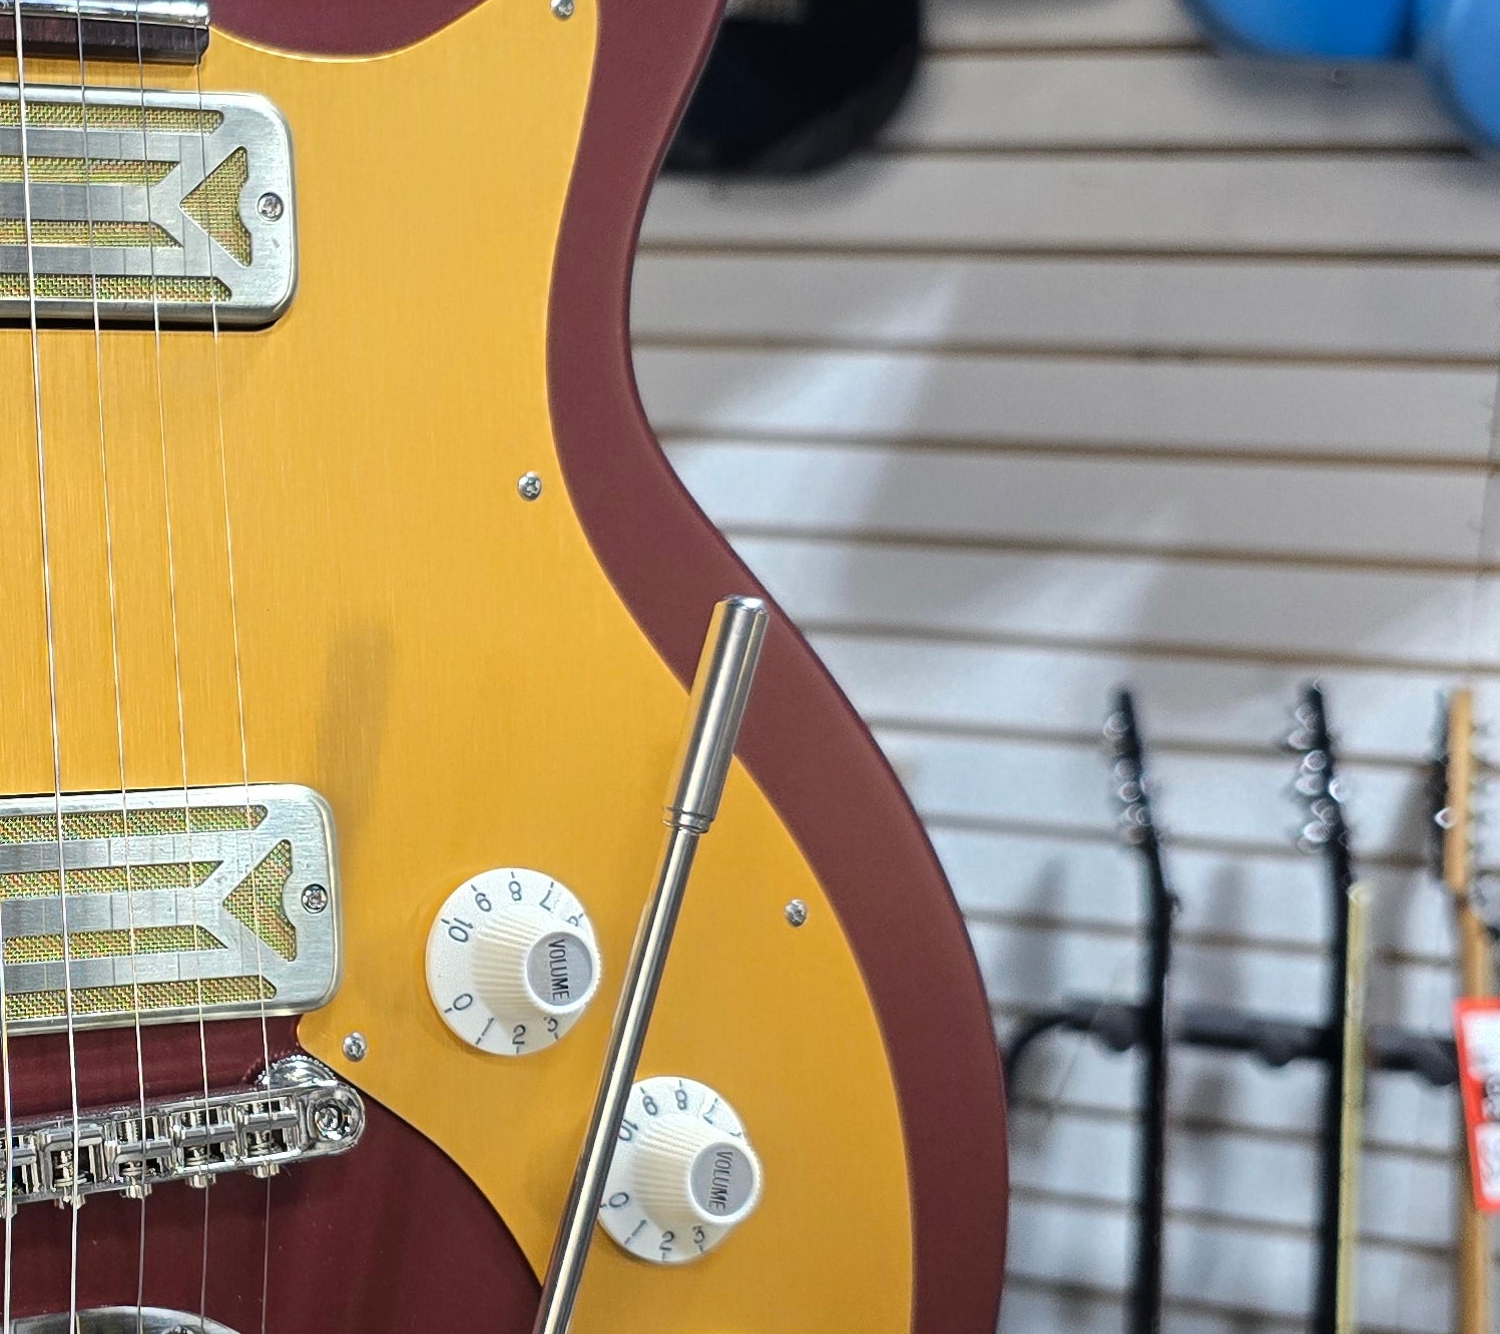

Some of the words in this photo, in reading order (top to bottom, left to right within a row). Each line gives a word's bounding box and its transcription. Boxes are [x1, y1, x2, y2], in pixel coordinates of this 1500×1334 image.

[508, 880, 523, 902] 8
[447, 917, 474, 943] 10
[548, 939, 570, 1001] VOLUME
[452, 993, 473, 1011] 0
[512, 1024, 526, 1045] 2
[674, 1089, 688, 1111] 8
[708, 1151, 734, 1211] VOLUME
[608, 1192, 630, 1208] 0
[659, 1230, 675, 1251] 2
[692, 1225, 706, 1244] 3
